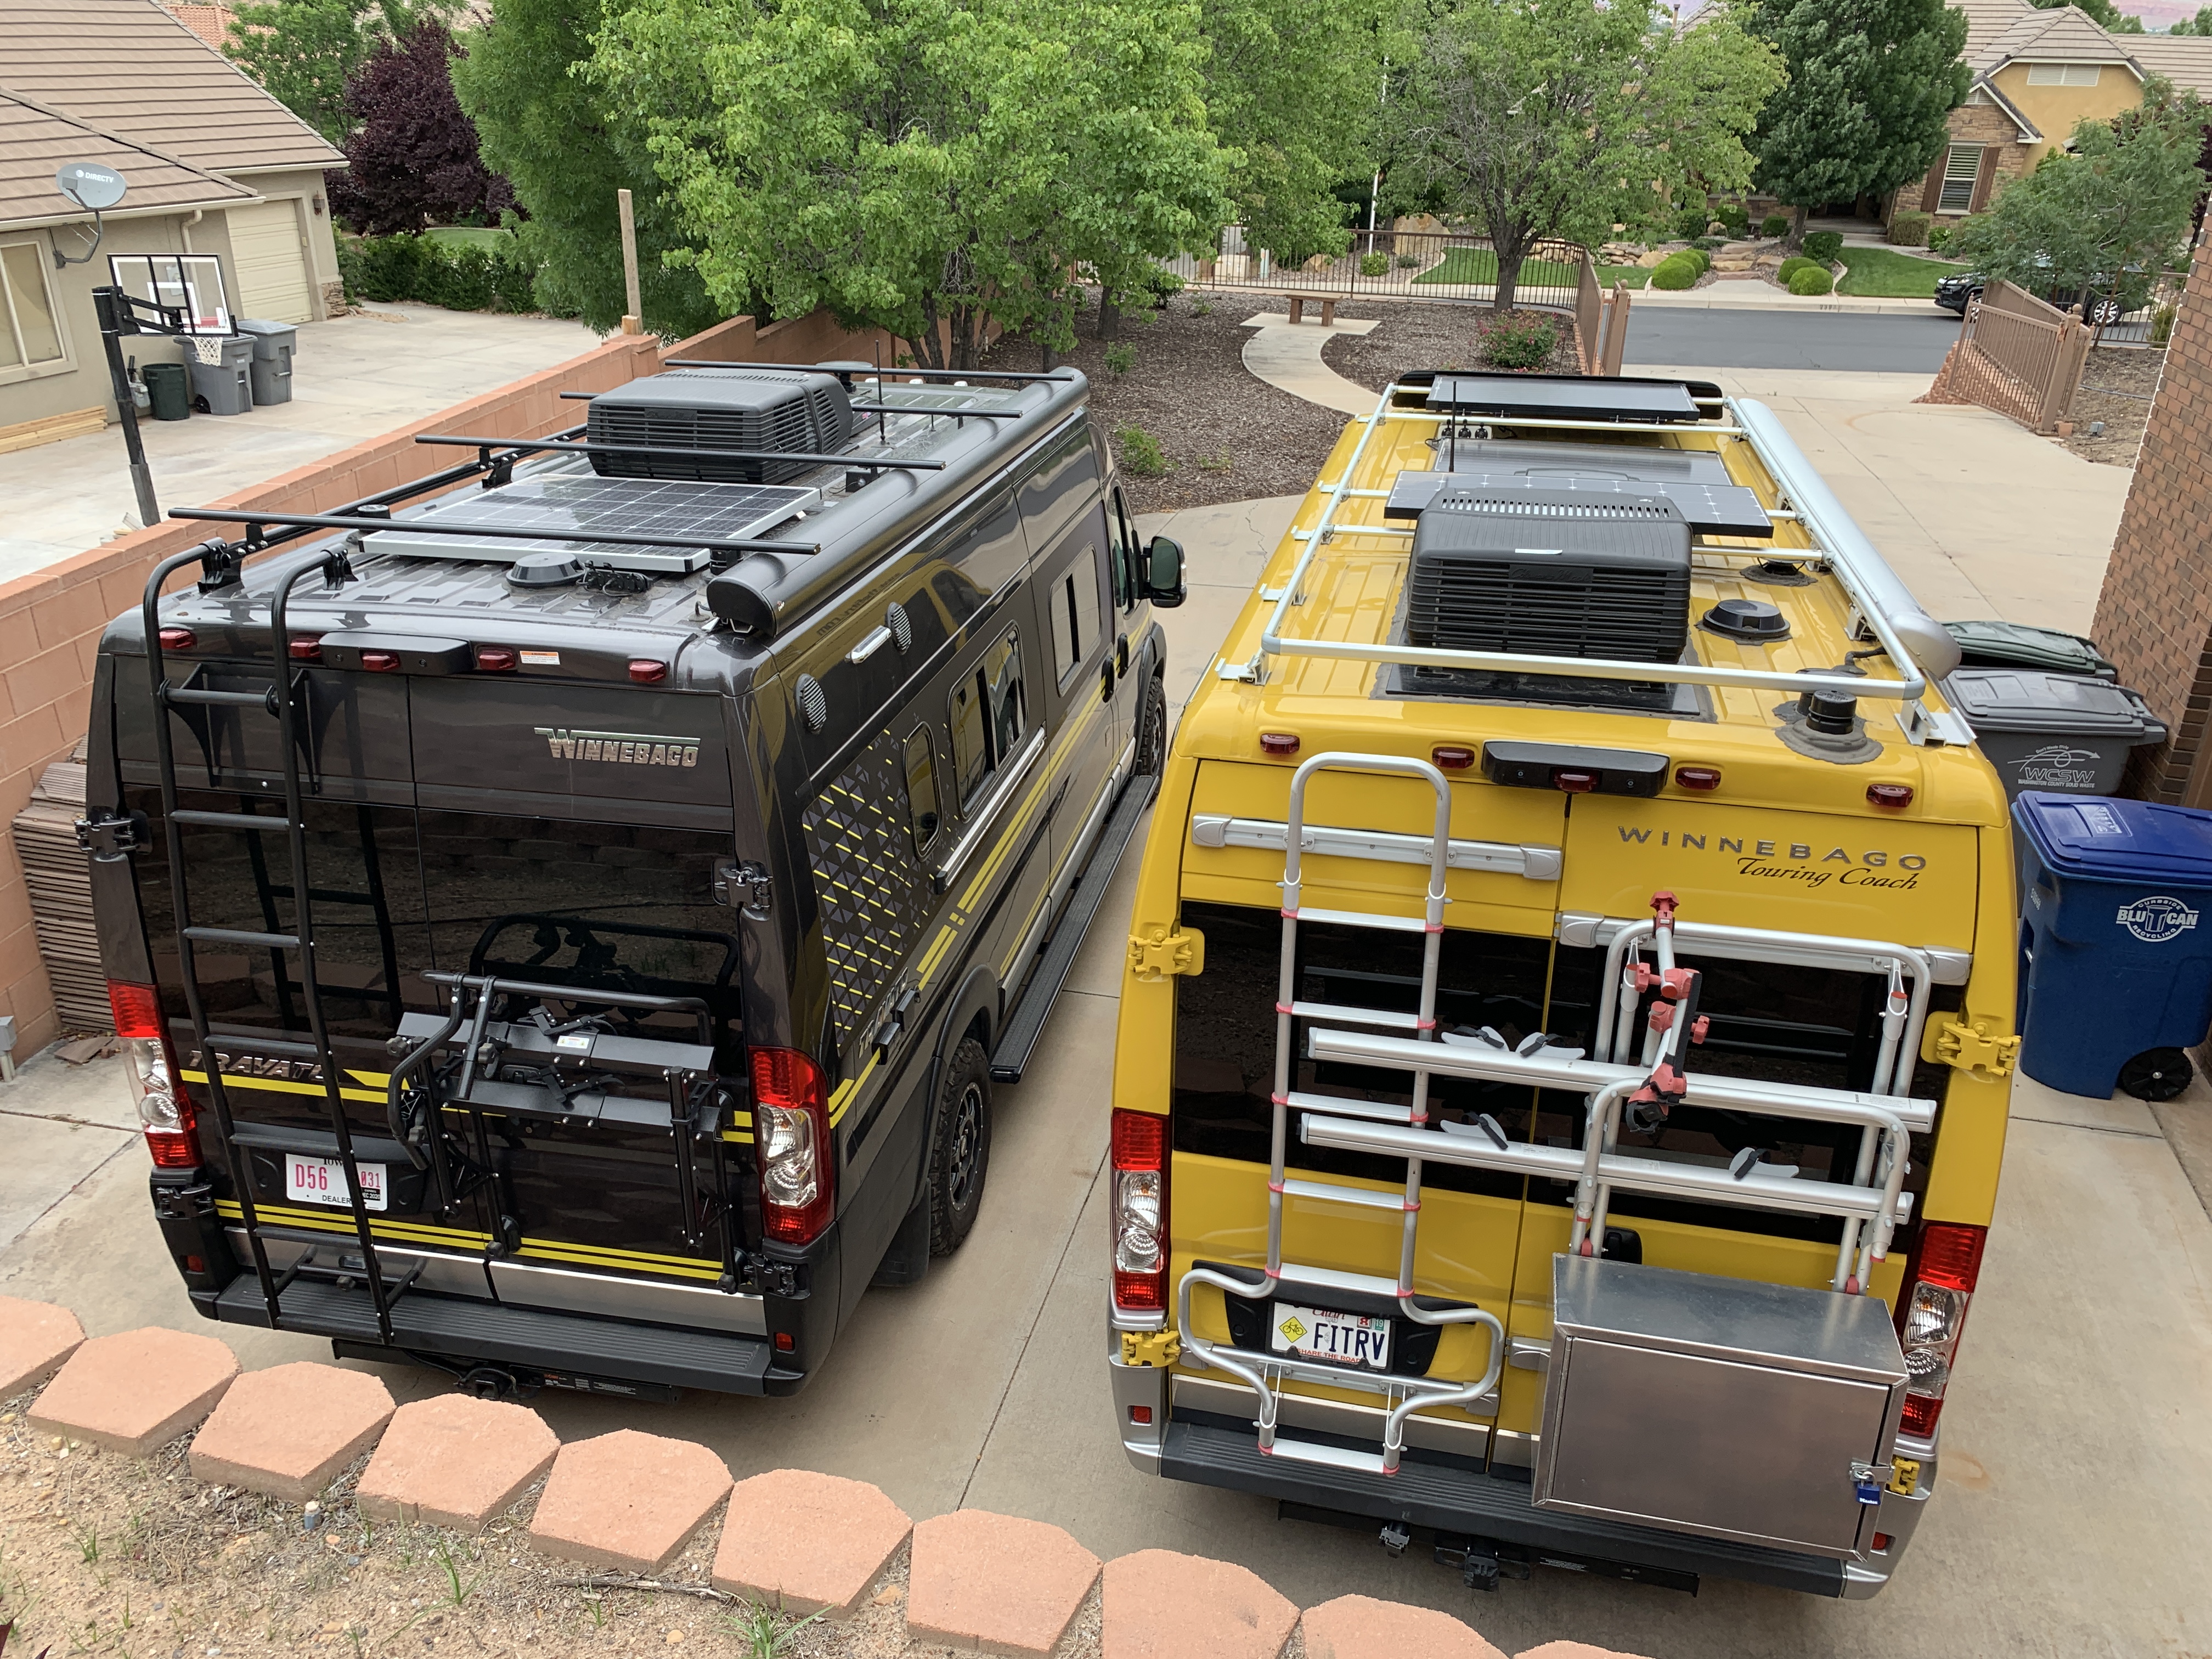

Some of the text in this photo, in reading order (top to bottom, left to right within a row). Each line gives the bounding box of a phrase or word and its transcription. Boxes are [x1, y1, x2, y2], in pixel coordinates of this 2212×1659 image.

[85, 172, 114, 183] DIRECTV
[534, 727, 701, 767] WINNEBAGO
[2024, 767, 2095, 783] WCSW
[1618, 826, 1926, 870] WINNEBAGO
[1737, 857, 1920, 889] Touring Coach
[2138, 899, 2182, 910] CURBSIDE
[2117, 909, 2199, 926] BLU CAN
[2132, 924, 2177, 939] RECYCLING
[295, 1164, 381, 1190] D56 031
[322, 1195, 352, 1205] DEALER
[1376, 1319, 1384, 1328] 19
[1313, 1322, 1385, 1360] FITRV
